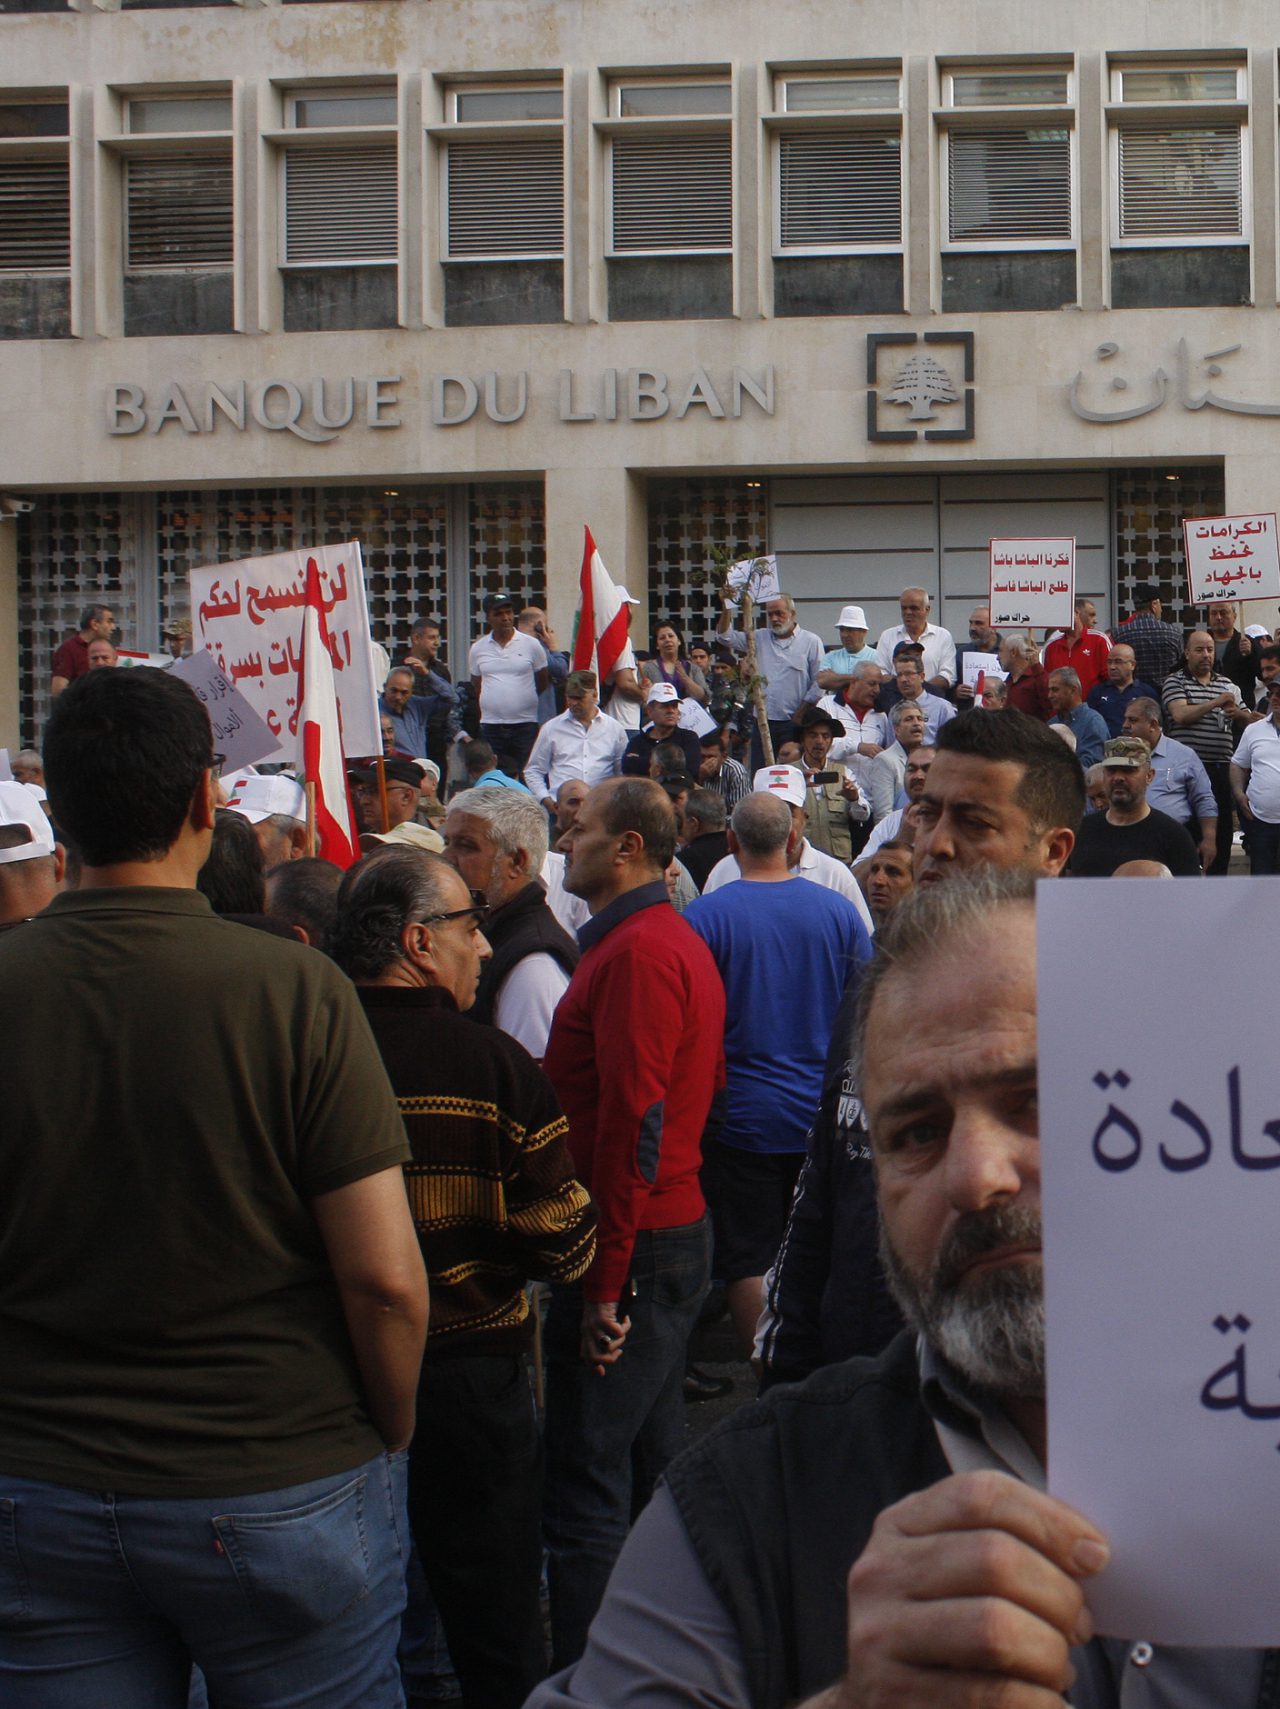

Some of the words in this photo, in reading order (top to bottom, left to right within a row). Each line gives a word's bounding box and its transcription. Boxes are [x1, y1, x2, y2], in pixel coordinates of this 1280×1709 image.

[106, 376, 402, 443] BANQUE
[432, 370, 529, 426] DU
[558, 364, 776, 422] LIBAN
[1195, 520, 1268, 540] الكرامات
[993, 553, 1013, 568] باشا
[1014, 553, 1043, 568] الباشا
[1208, 540, 1255, 561] تحفظ
[1204, 565, 1262, 586] بالجهاد
[1017, 580, 1046, 596] الباشا
[1048, 580, 1069, 596] طلع
[199, 579, 241, 638] لحكم
